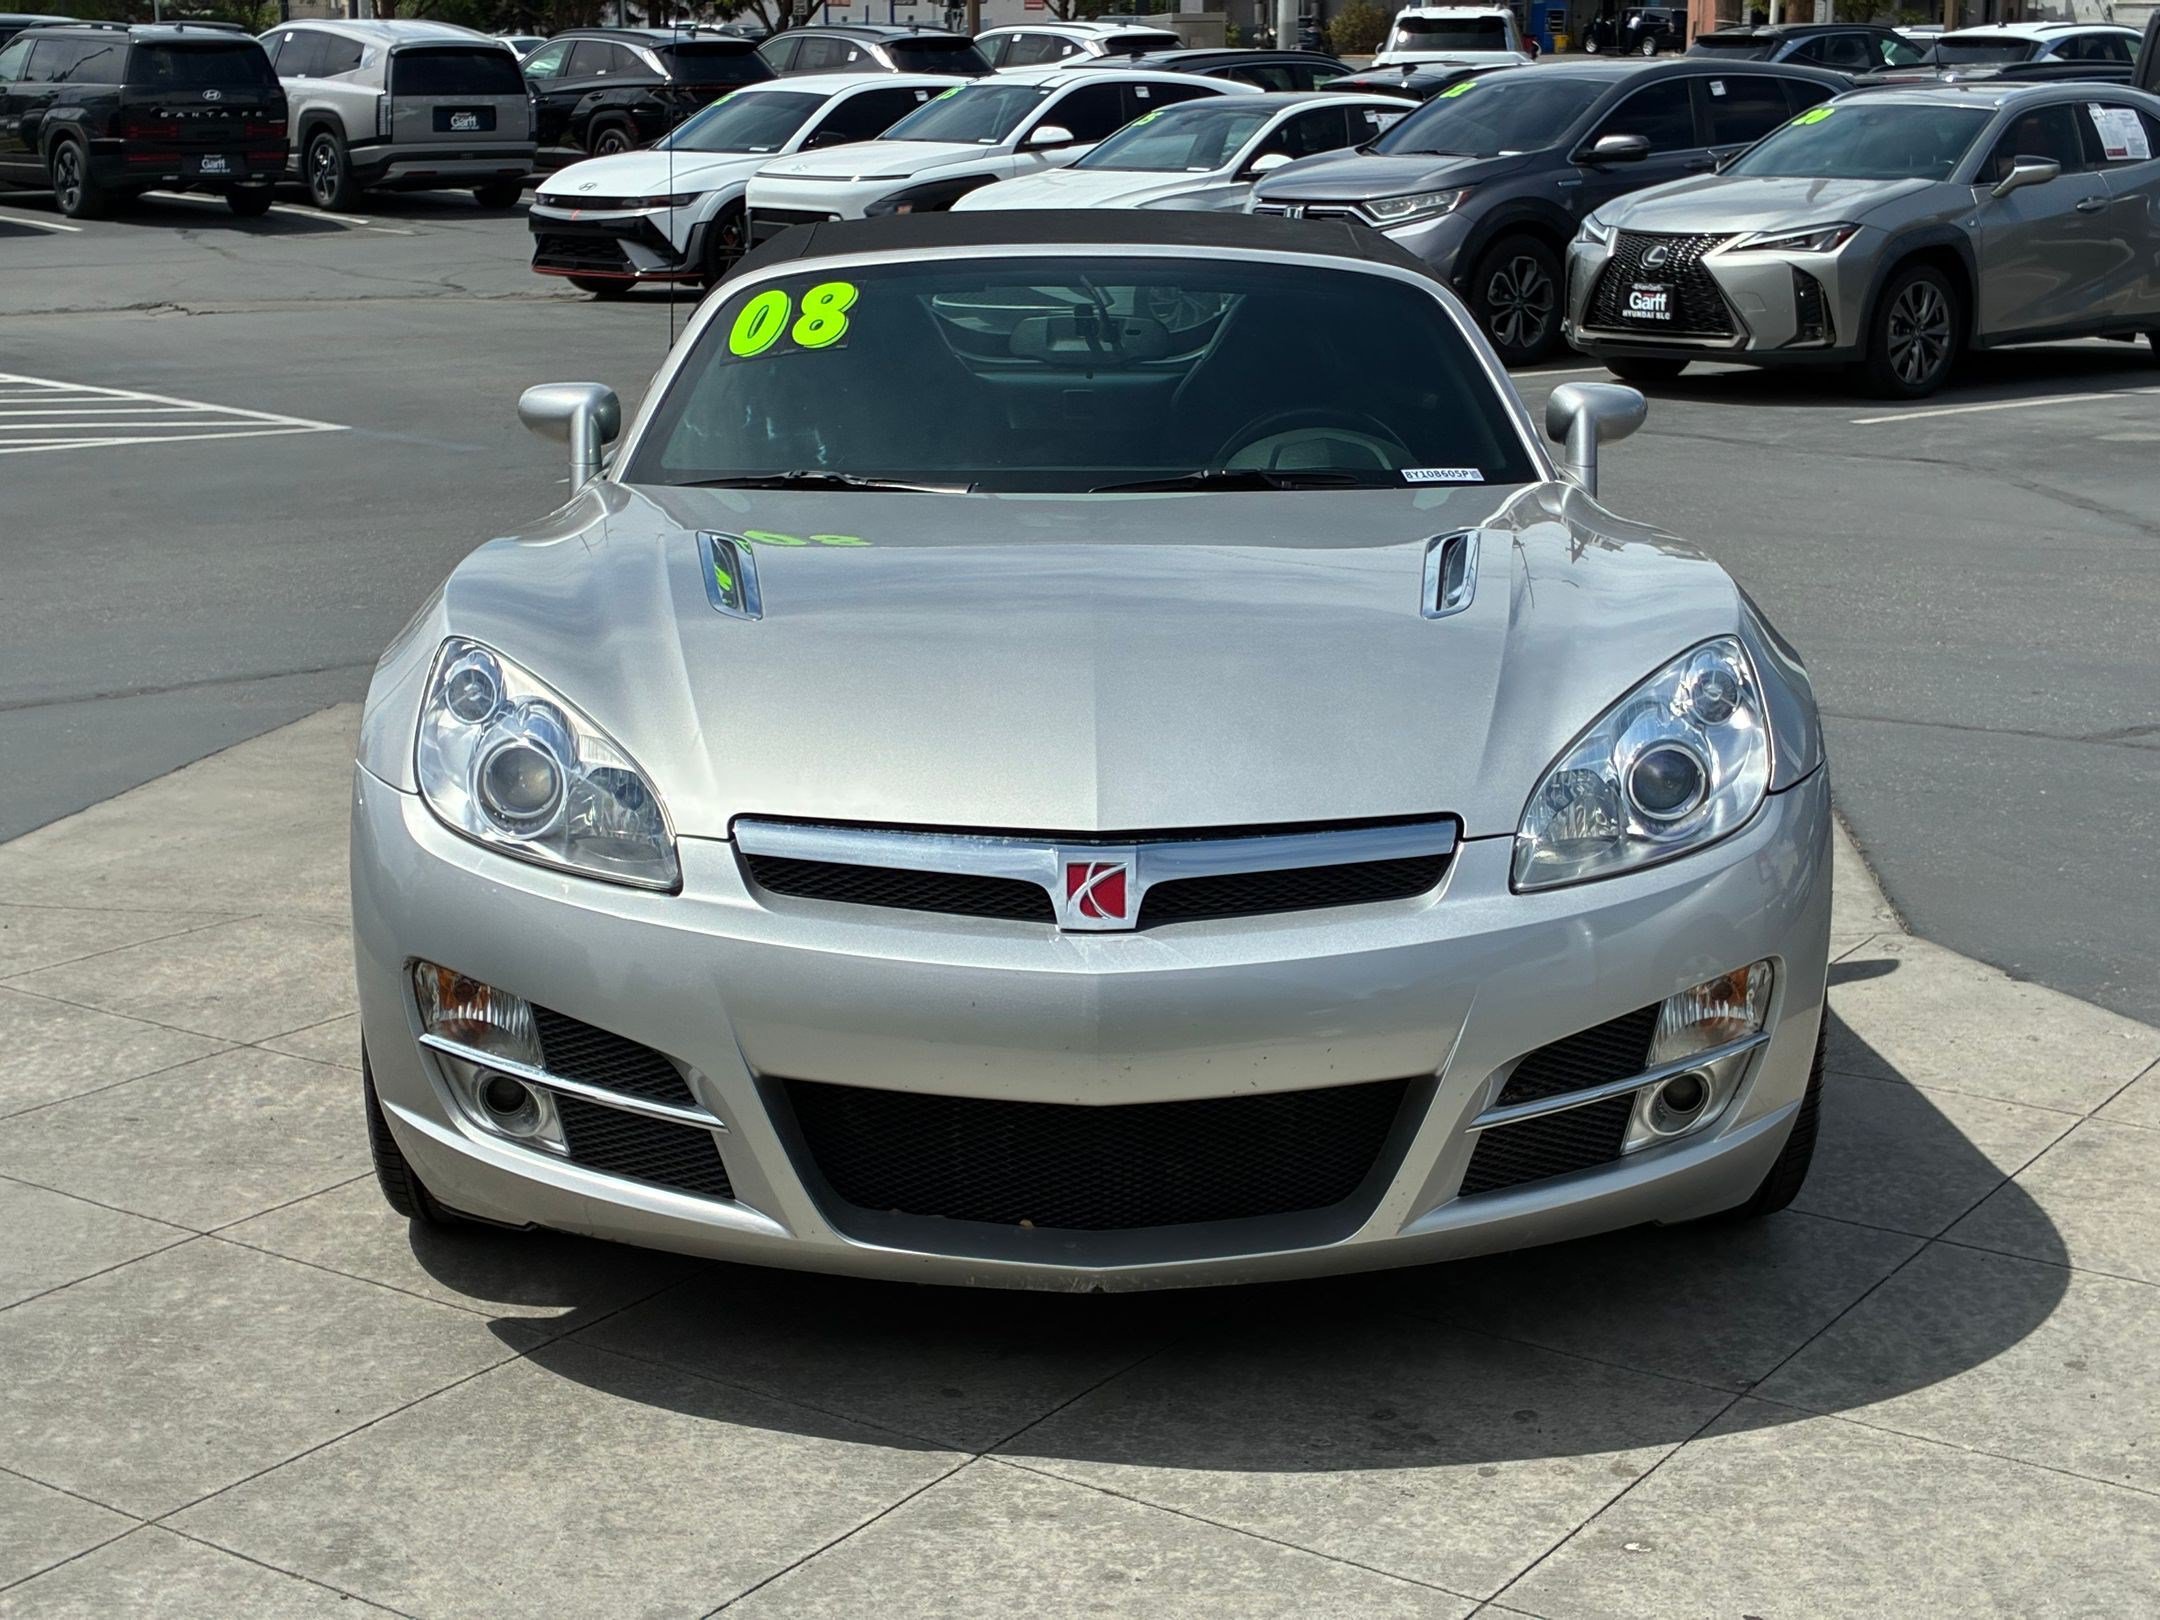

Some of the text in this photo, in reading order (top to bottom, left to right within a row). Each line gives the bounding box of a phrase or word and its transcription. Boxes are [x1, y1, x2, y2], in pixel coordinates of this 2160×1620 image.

[1629, 291, 1667, 311] Garff
[729, 282, 859, 357] 08
[1622, 309, 1655, 319] HYUNDAI
